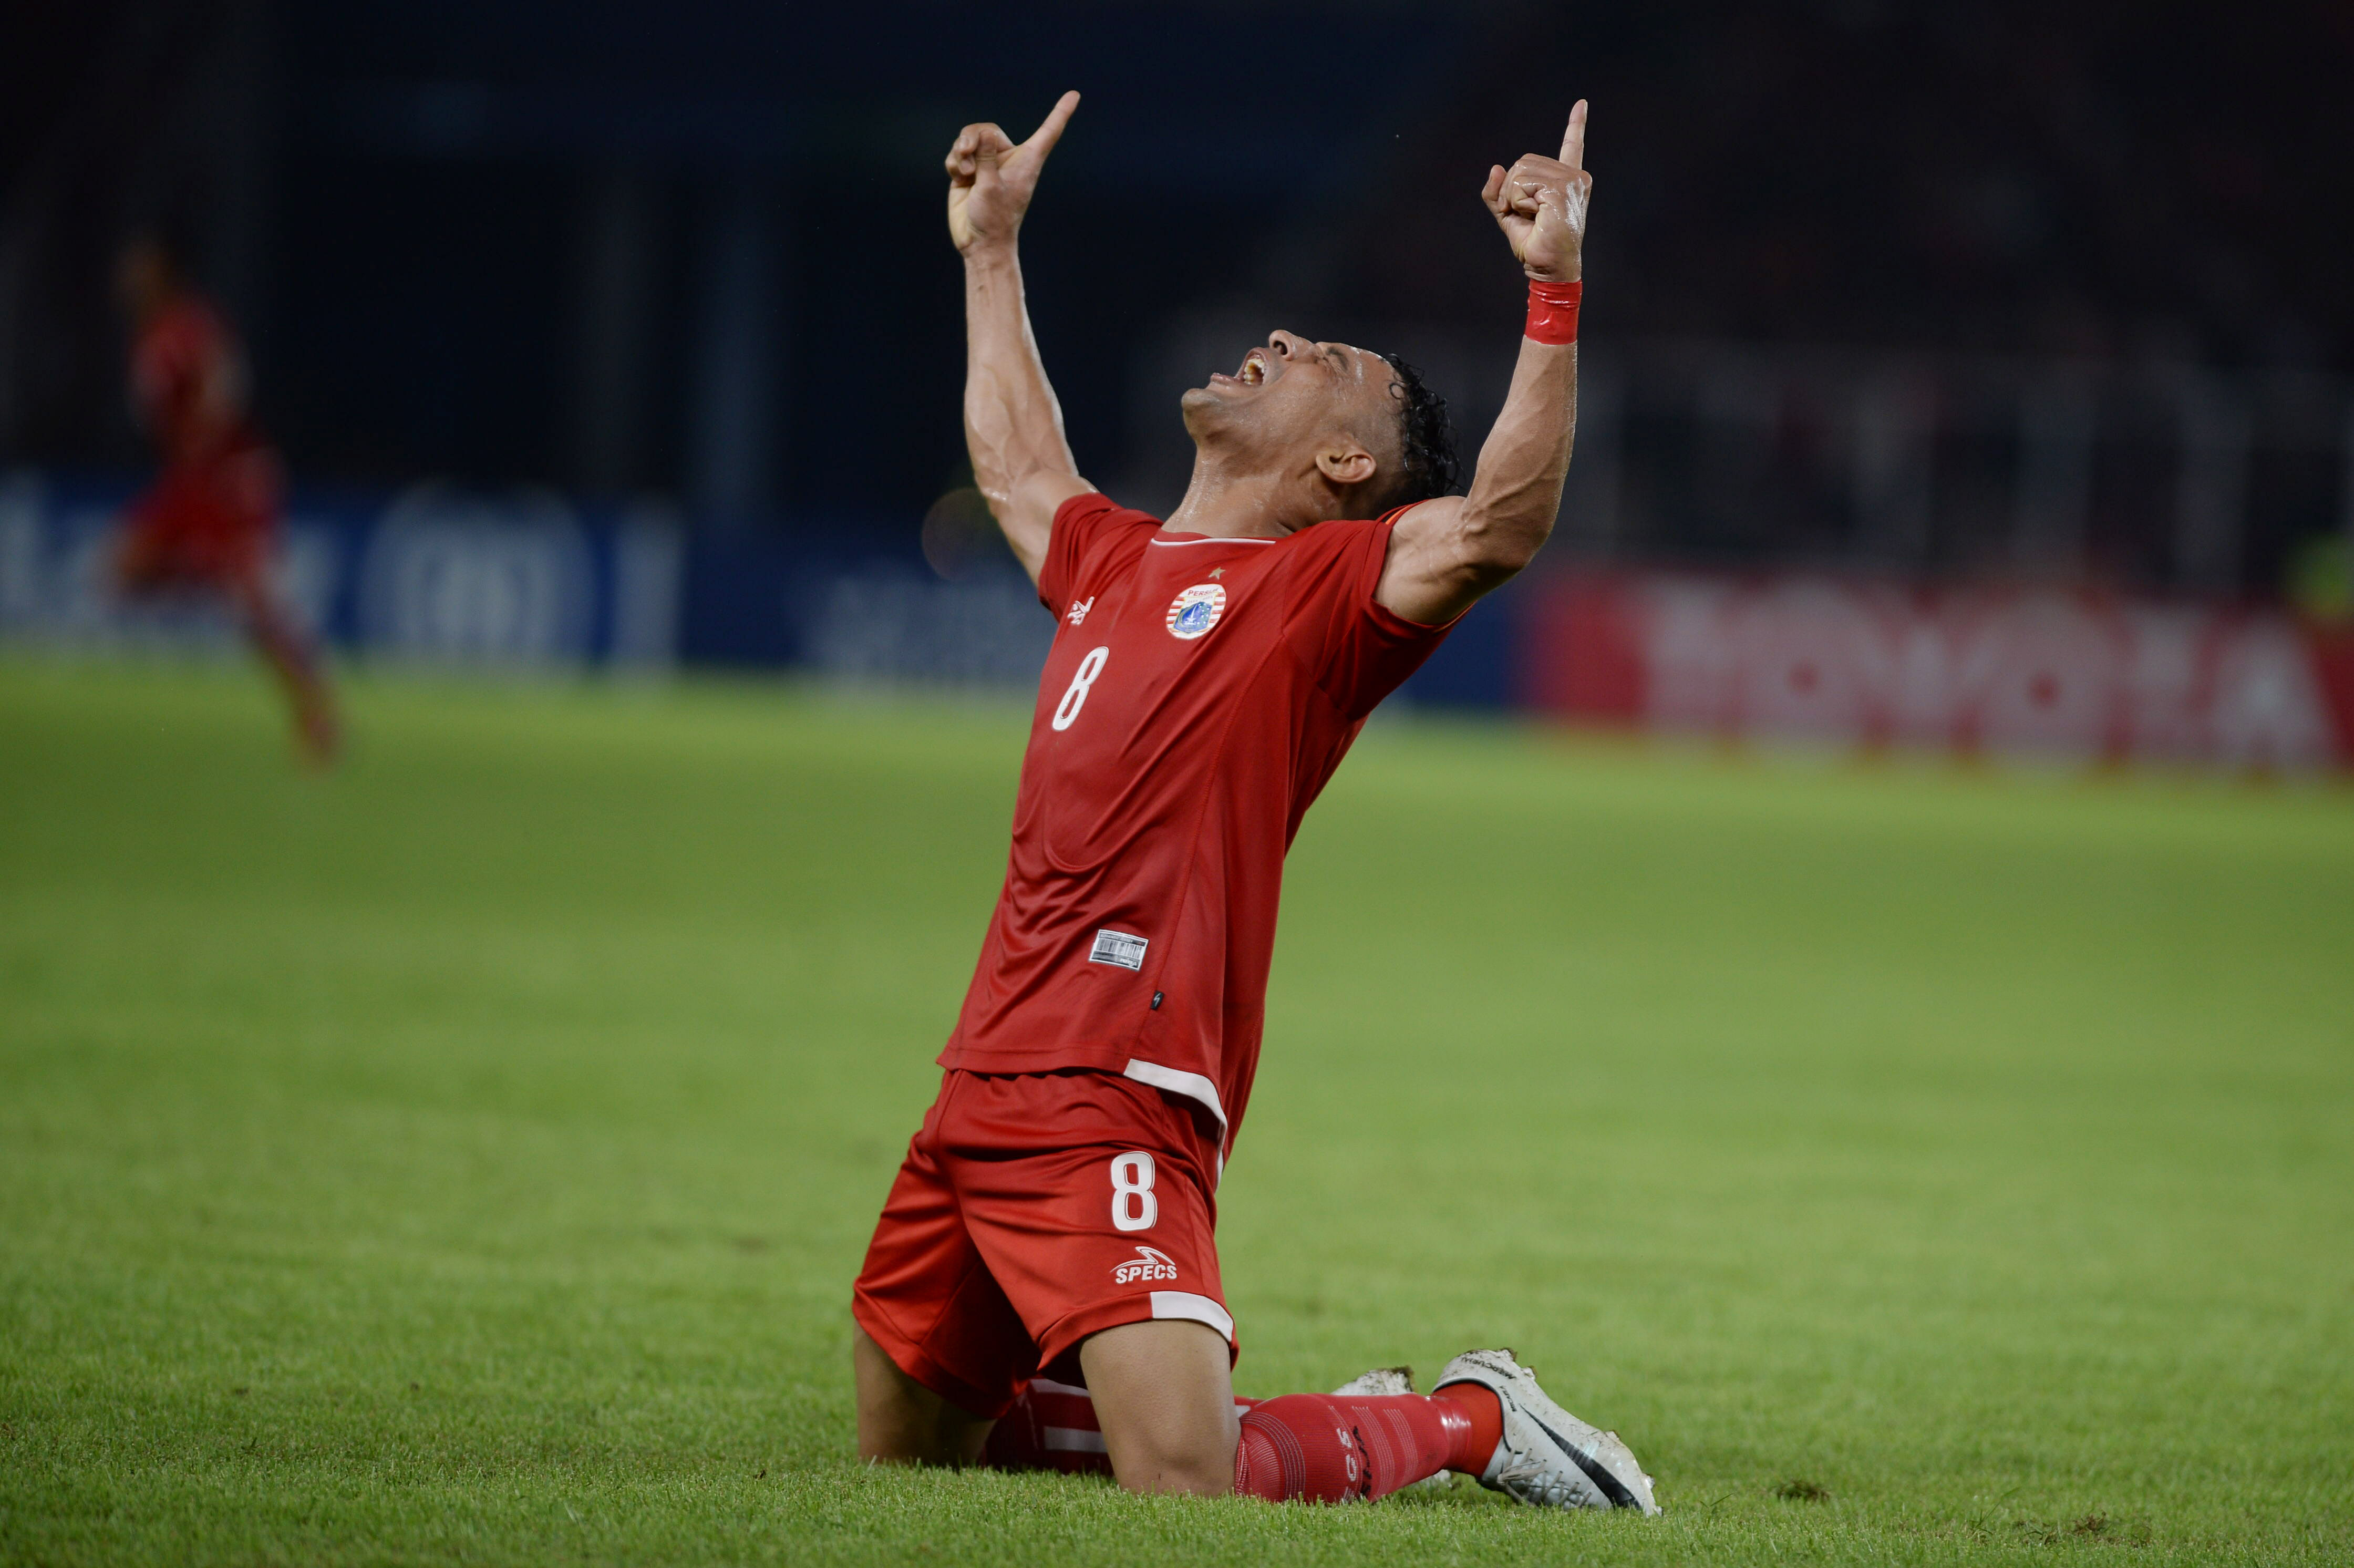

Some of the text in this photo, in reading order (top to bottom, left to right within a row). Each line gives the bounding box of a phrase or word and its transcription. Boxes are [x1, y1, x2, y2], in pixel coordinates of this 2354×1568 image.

[1052, 646, 1109, 731] 8
[1639, 578, 2330, 765] TOYOTA
[1111, 1151, 1158, 1231] 8
[1115, 1264, 1178, 1284] SPECS
